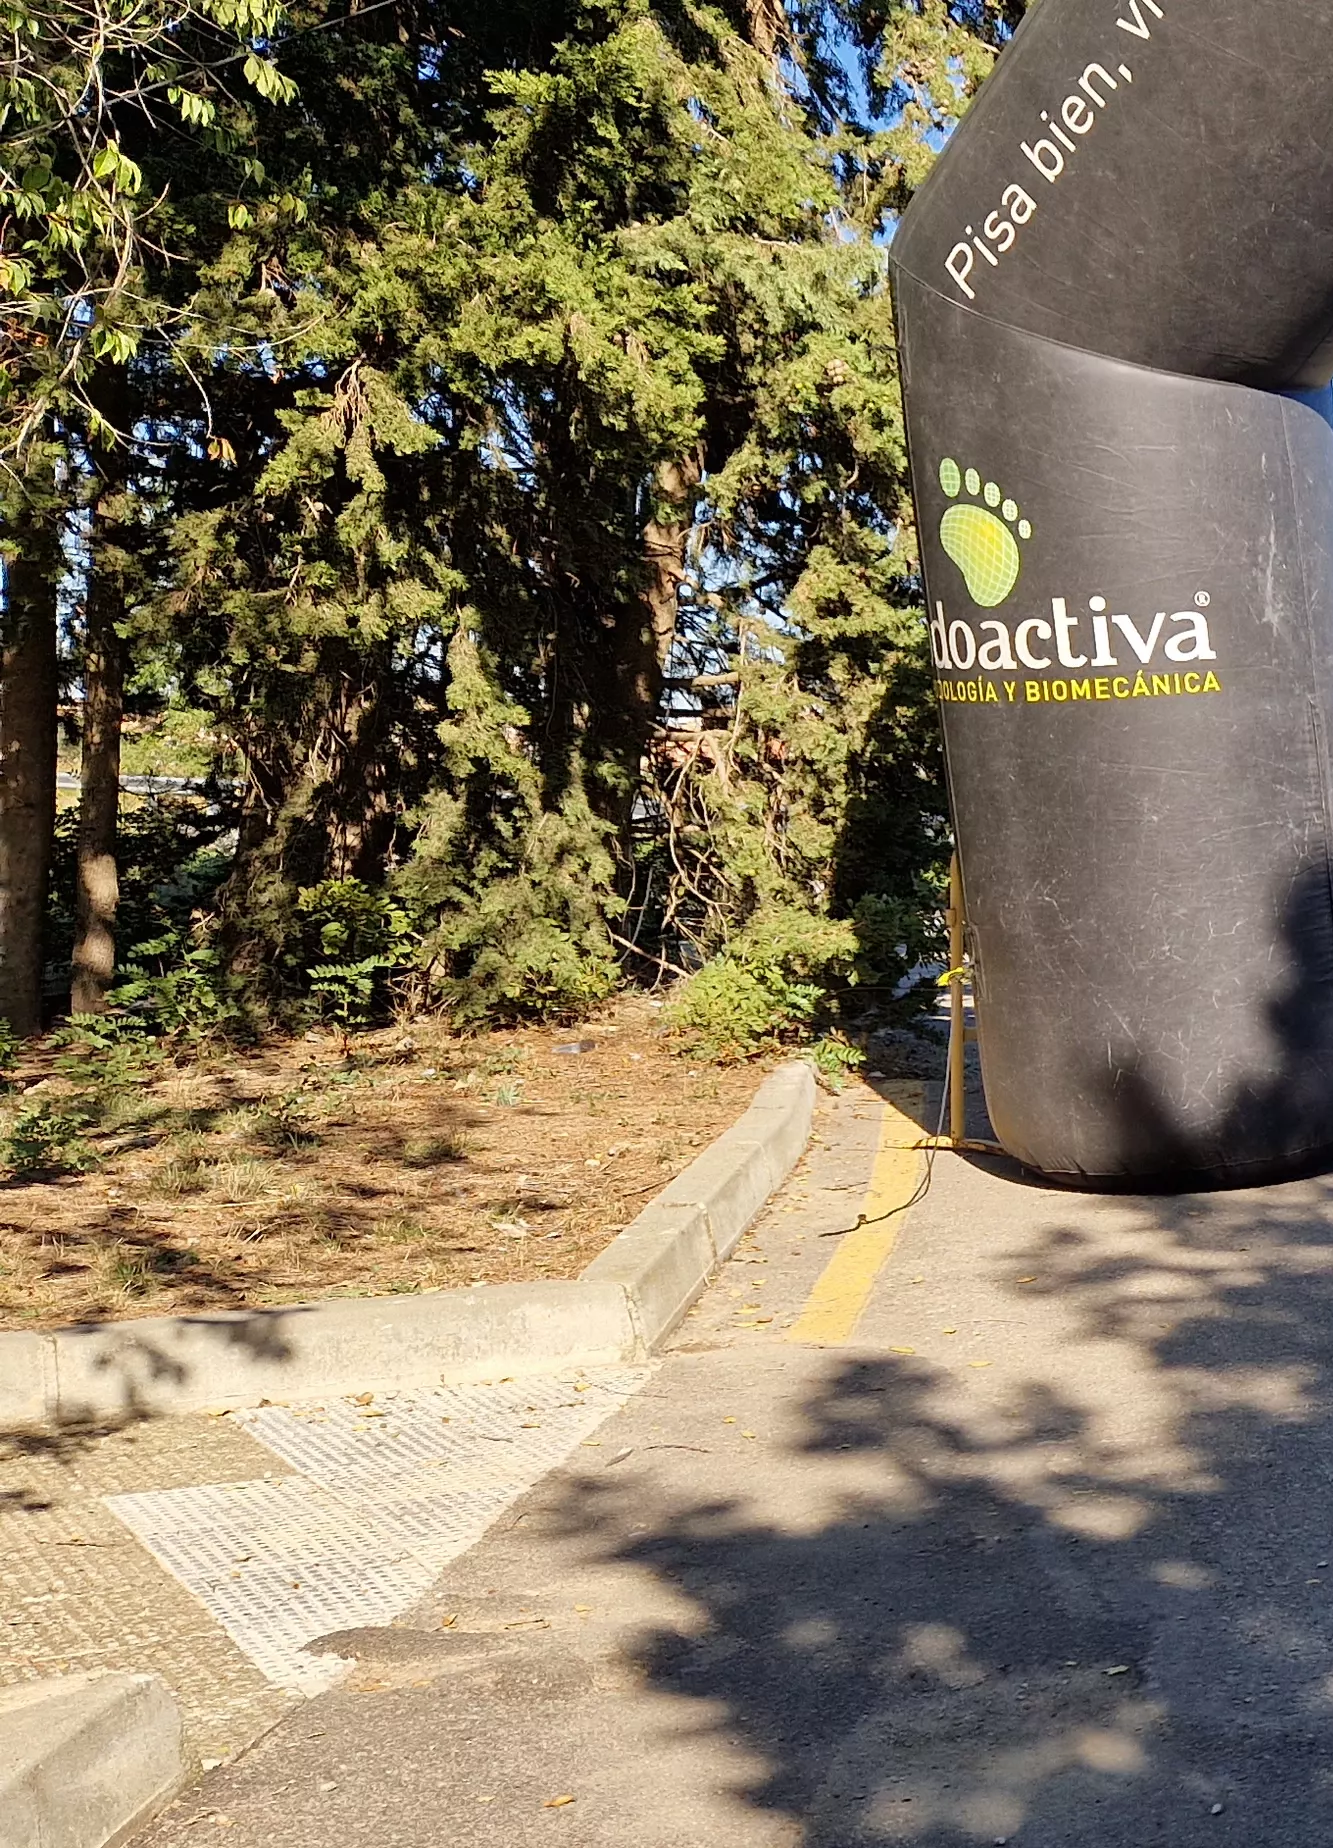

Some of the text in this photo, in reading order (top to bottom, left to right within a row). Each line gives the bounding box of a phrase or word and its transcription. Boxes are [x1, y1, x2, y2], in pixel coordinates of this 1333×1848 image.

[944, 183, 1038, 299] Pisa
[1019, 62, 1133, 184] bien,
[1003, 680, 1016, 702] Y
[1025, 669, 1221, 702] BIOMECÁNICA
